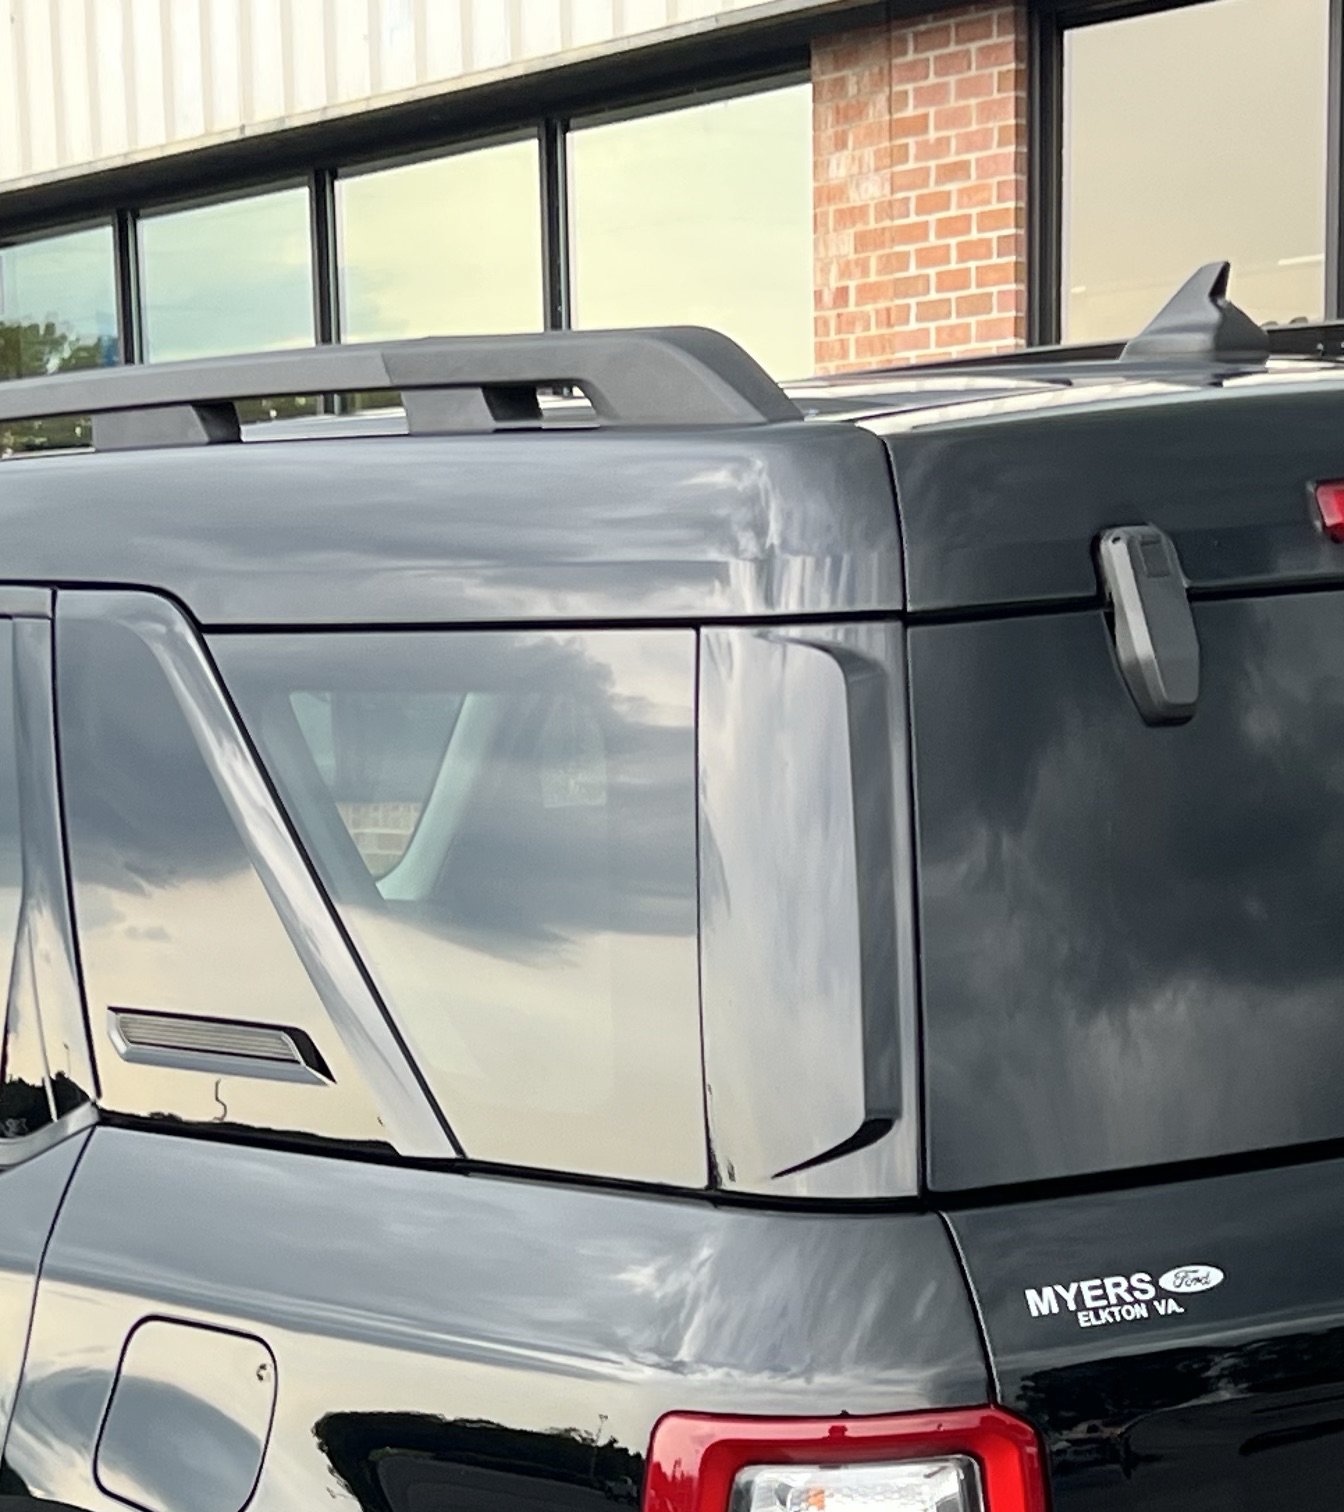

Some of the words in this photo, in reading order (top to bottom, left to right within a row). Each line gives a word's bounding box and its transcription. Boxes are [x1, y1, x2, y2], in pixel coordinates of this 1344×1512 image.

[1024, 1272, 1157, 1317] MYERS
[1076, 1303, 1149, 1328] ELKTON
[1152, 1298, 1185, 1316] VA.
